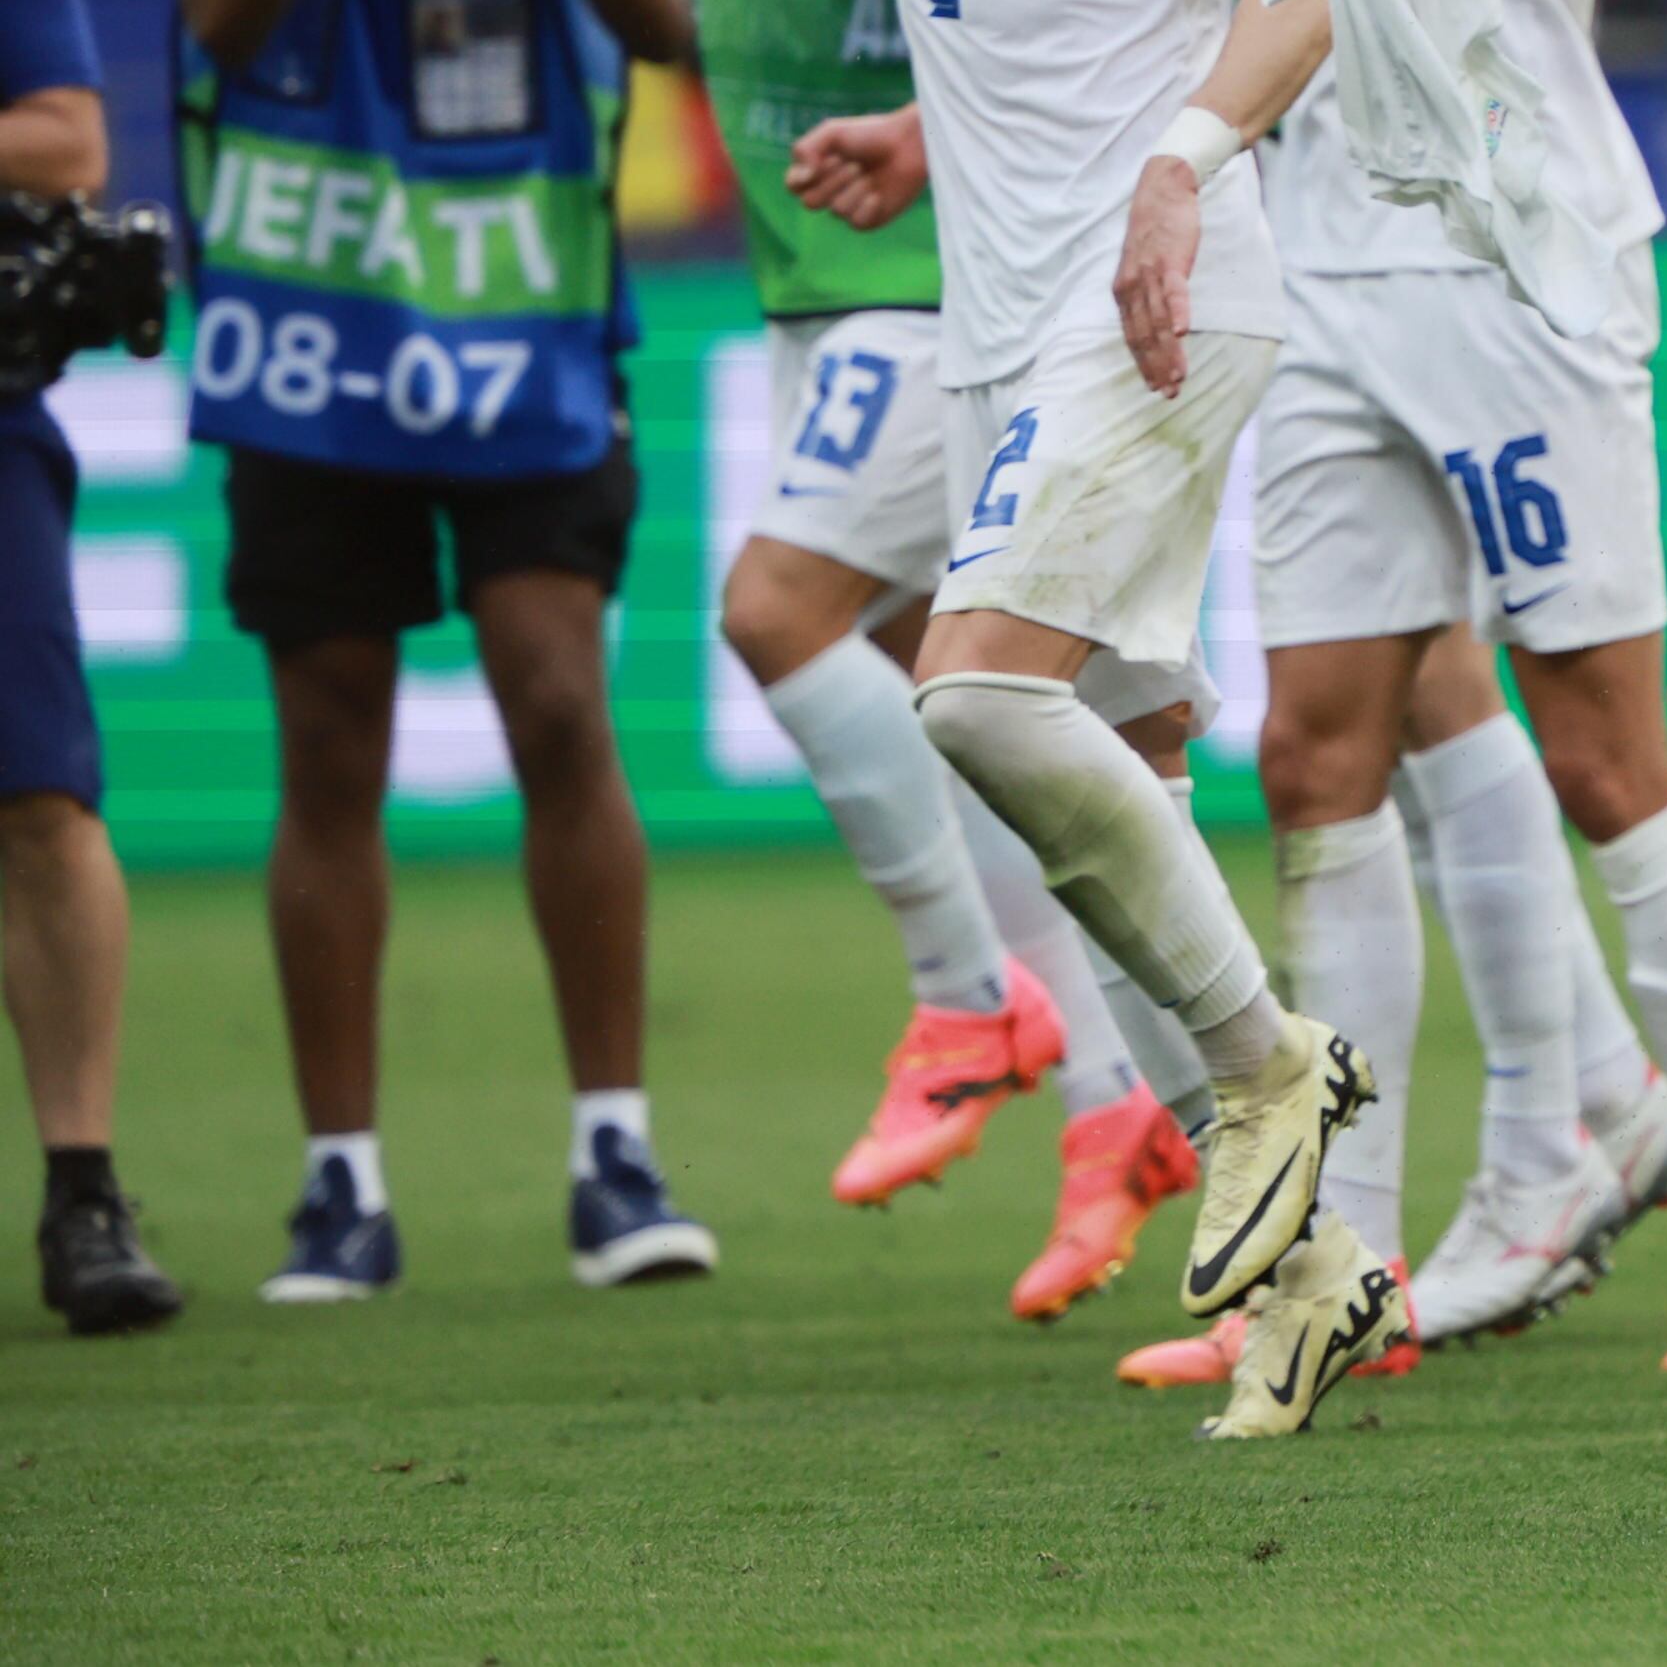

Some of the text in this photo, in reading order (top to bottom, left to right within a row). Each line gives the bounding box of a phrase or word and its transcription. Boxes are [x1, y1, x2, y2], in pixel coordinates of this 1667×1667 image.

[192, 296, 532, 437] 08-07
[795, 351, 897, 474] 13
[968, 405, 1040, 532] 2
[1444, 432, 1569, 580] 16
